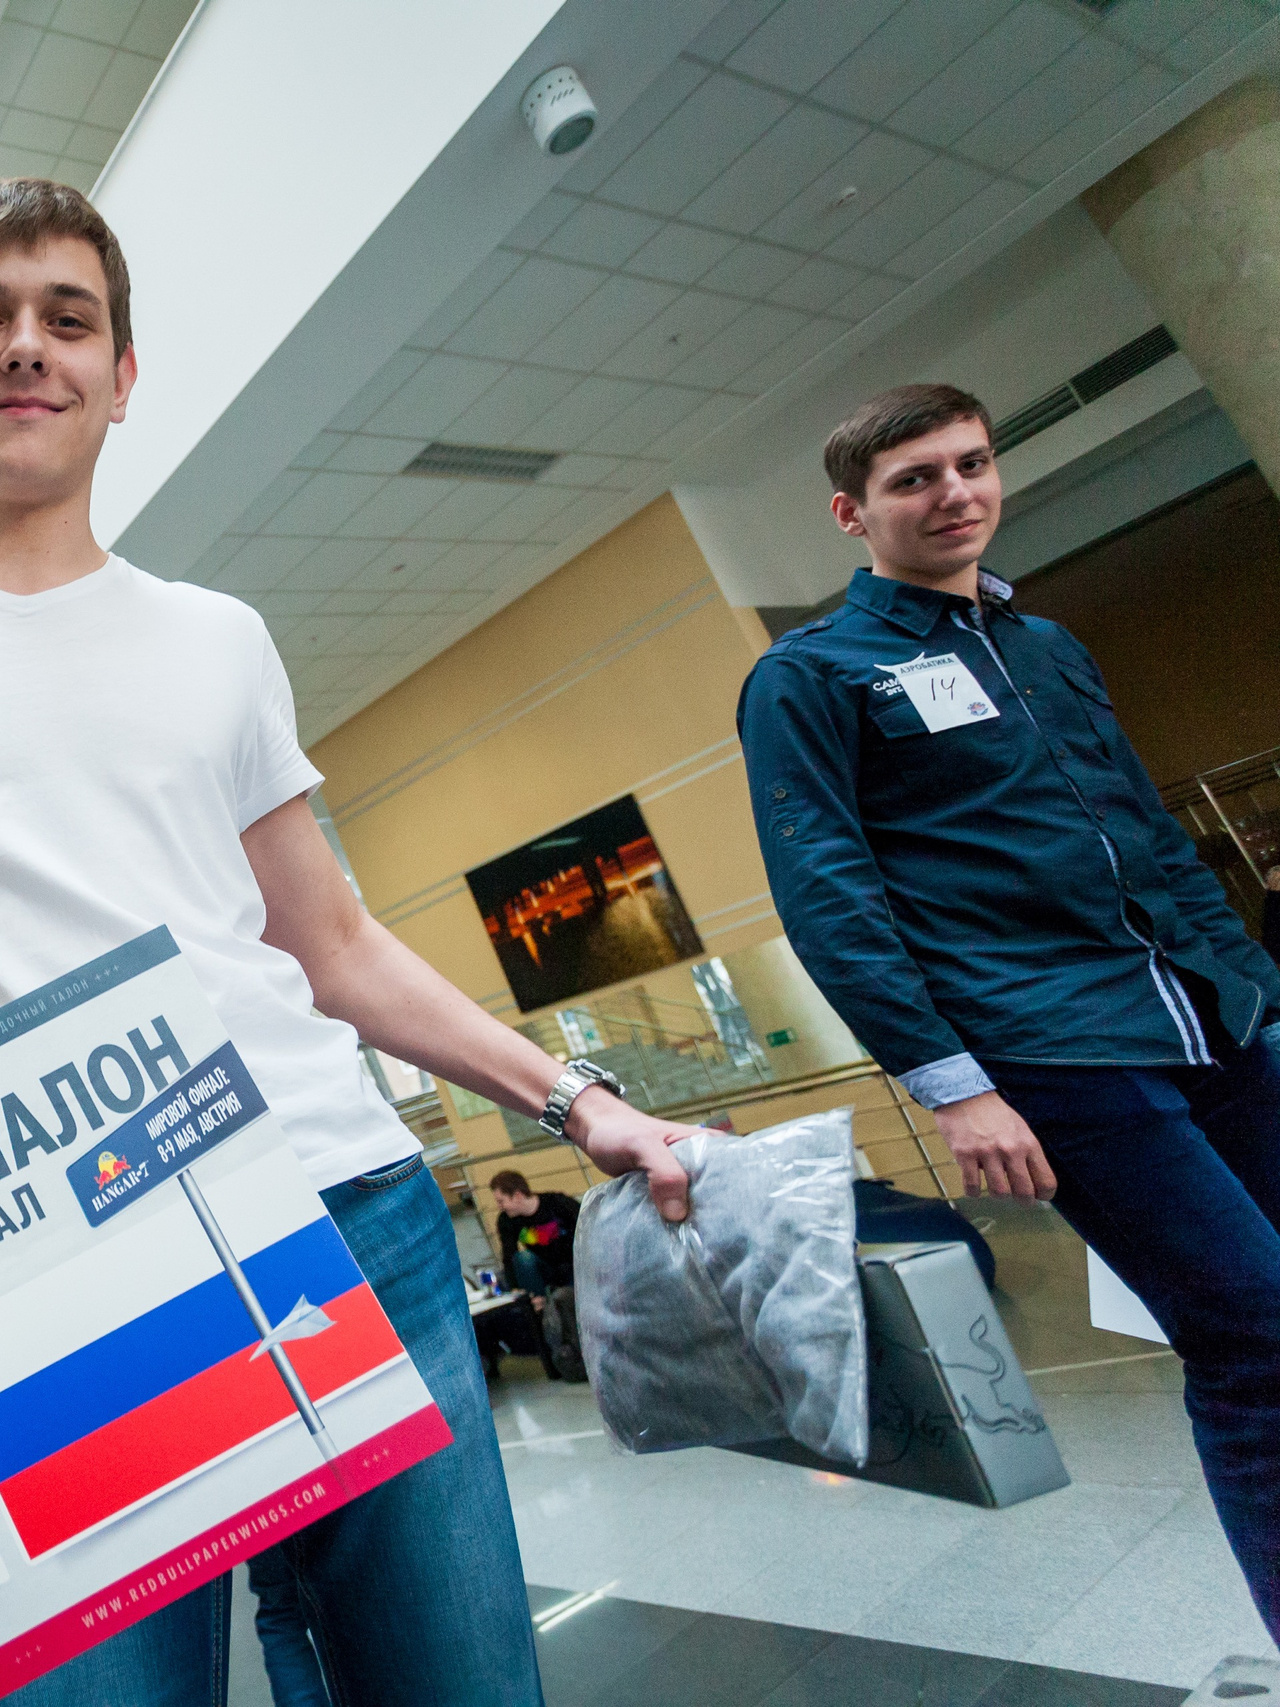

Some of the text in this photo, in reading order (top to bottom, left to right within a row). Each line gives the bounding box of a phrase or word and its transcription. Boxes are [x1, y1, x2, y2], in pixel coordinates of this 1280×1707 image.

[931, 677, 957, 701] 14
[51, 978, 90, 1006] ТАЛОН
[145, 1066, 231, 1141] МИРОВОЙ ФИНАЛ:
[156, 1090, 243, 1164] 8-9 МАЯ, АВСТРИЯ
[91, 1160, 151, 1212] HANGAR-7
[80, 1482, 328, 1630] WWW.REDBULLPAPERWINGS.COM
